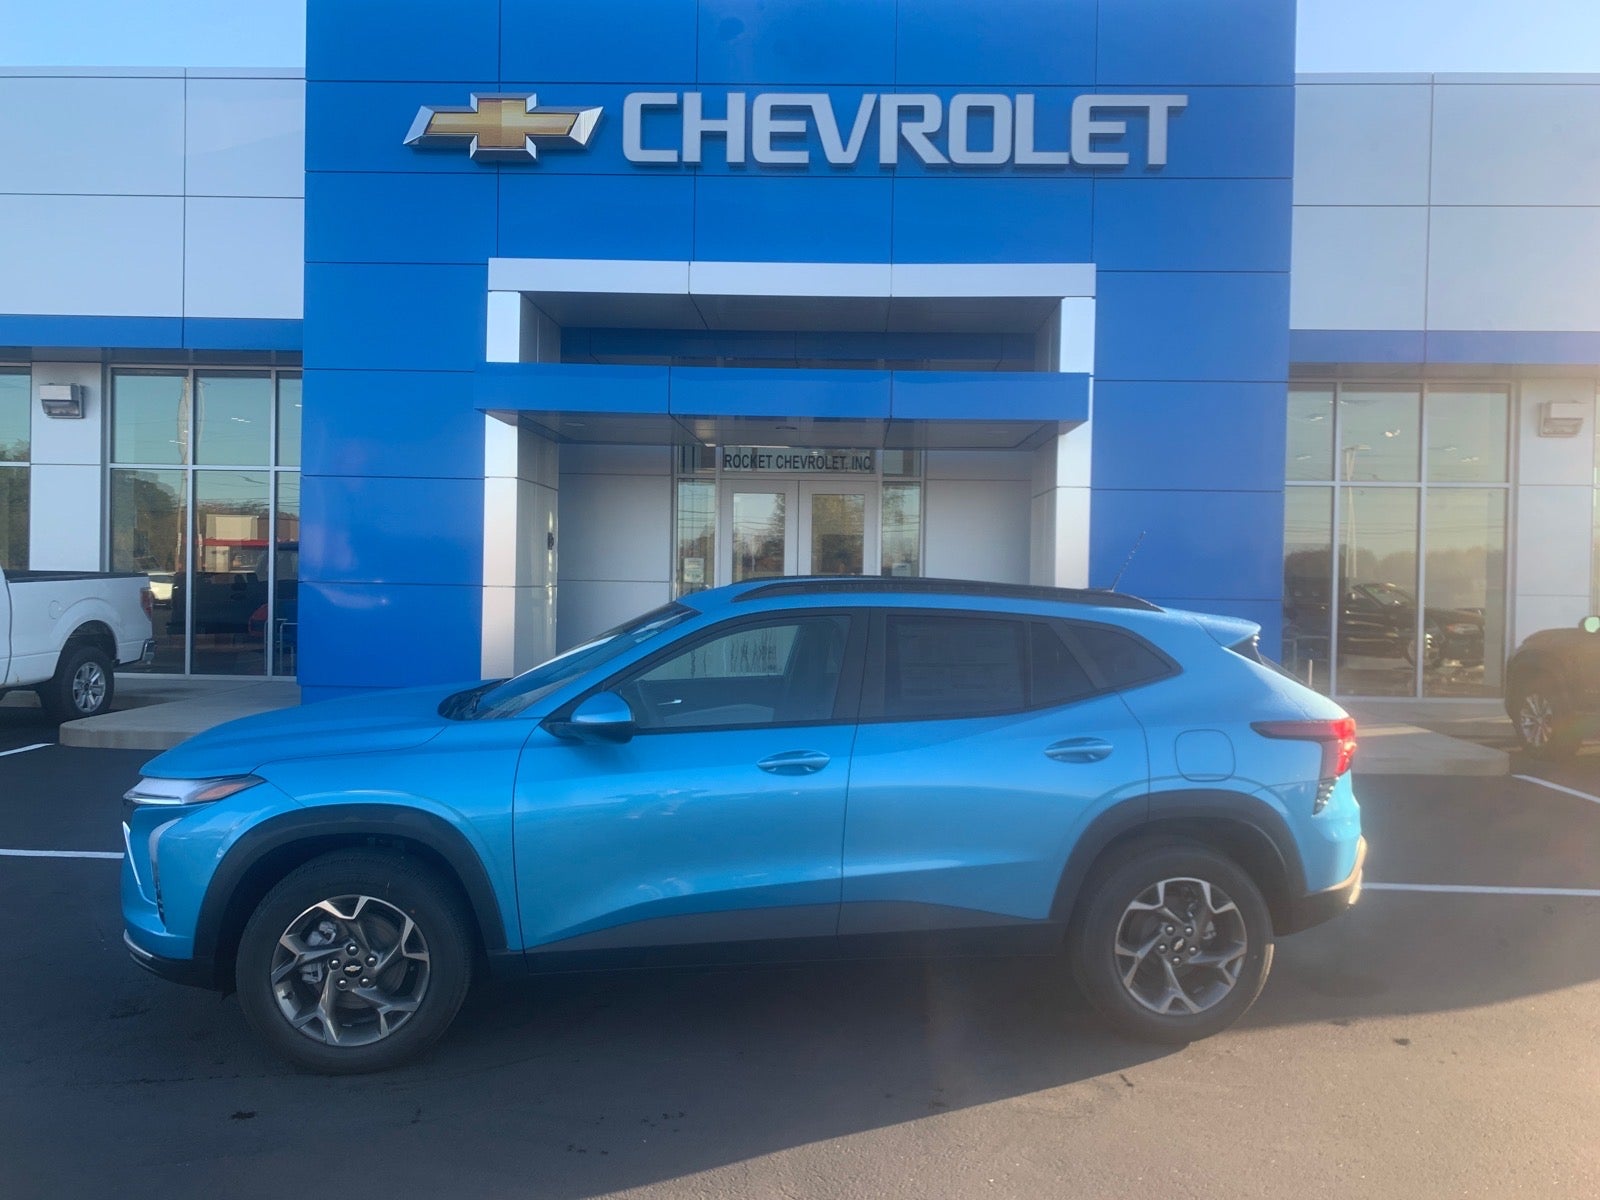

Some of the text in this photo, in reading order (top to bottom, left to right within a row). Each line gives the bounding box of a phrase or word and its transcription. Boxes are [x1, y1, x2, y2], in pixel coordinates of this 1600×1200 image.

[622, 91, 1189, 166] CHEVROLET
[724, 453, 773, 470] ROCKET
[851, 455, 875, 471] INC.
